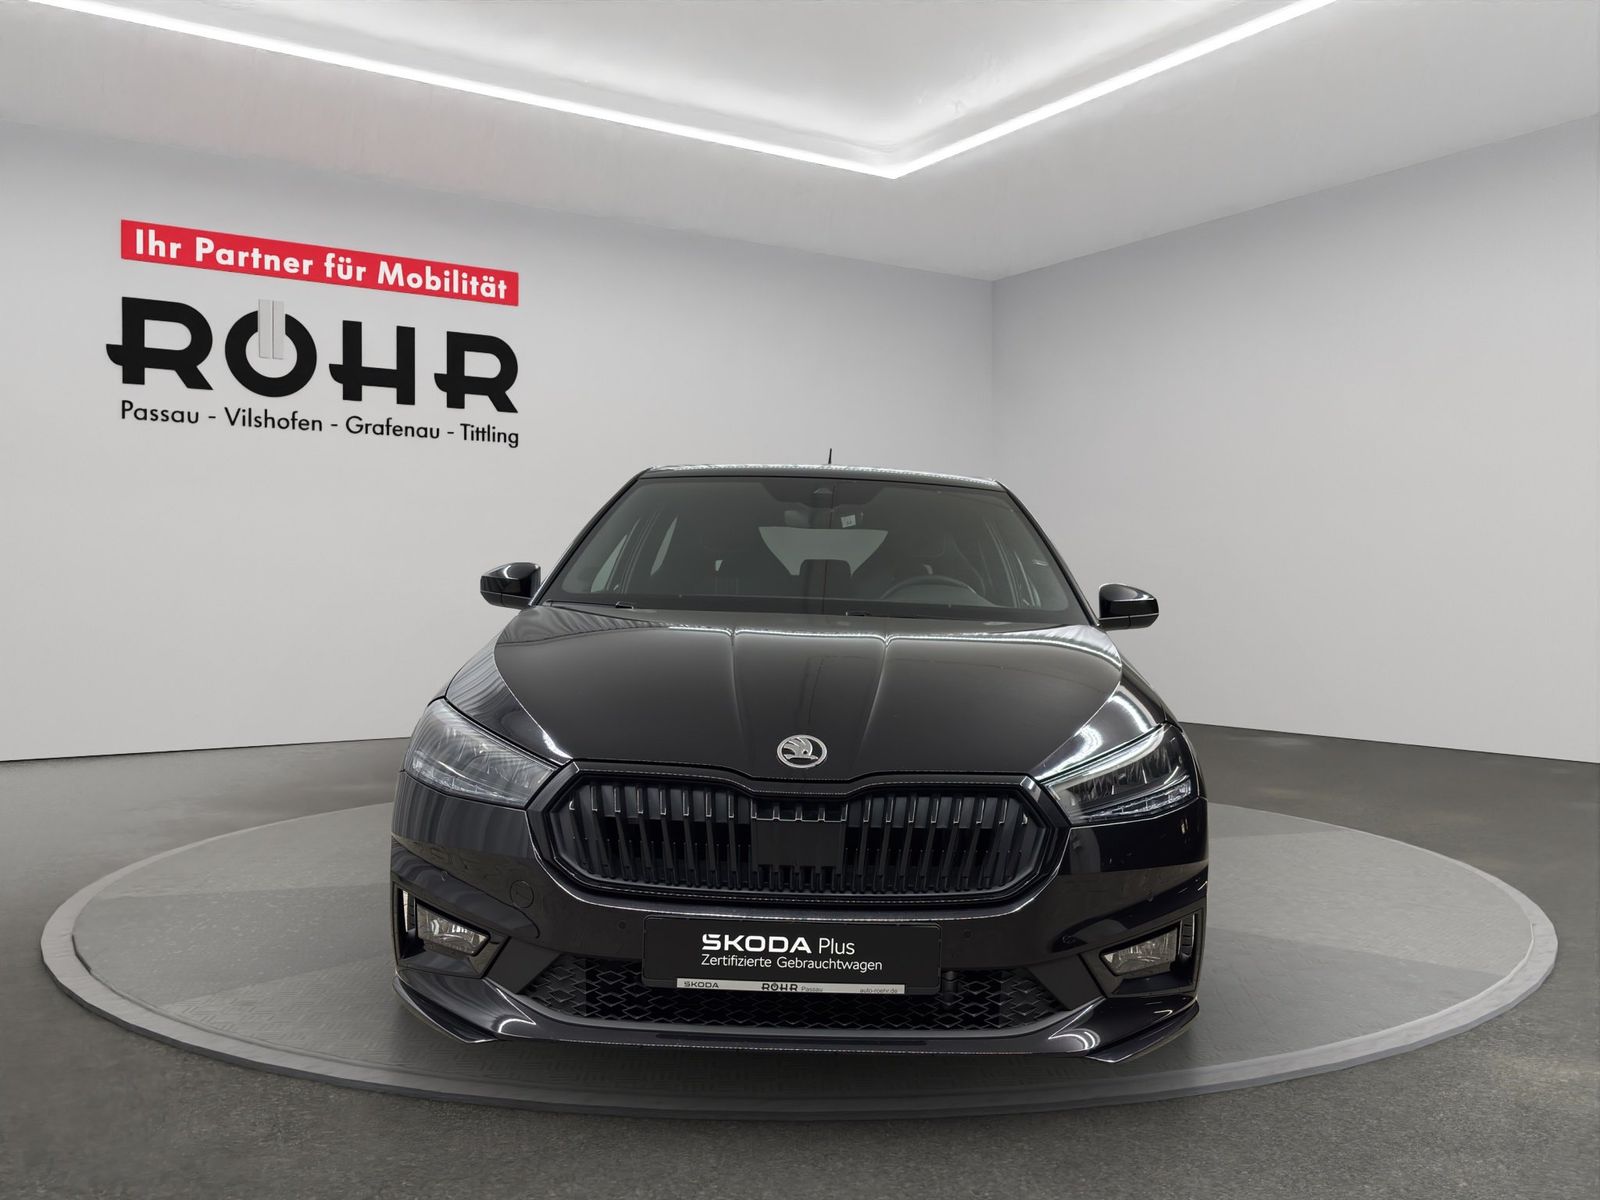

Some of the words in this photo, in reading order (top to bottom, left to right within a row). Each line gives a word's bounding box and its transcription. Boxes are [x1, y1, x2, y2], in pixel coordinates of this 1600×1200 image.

[135, 228, 182, 259] Ihr
[195, 236, 314, 275] Partner
[323, 252, 367, 282] für
[377, 260, 507, 299] Mobilität
[121, 400, 199, 424] Passau
[224, 407, 323, 432] Vilshofen
[345, 416, 440, 439] Grafenau
[460, 423, 519, 449] Tittling
[701, 954, 772, 968] Zertifizierte
[776, 956, 883, 973] Gebrauchtwagen
[818, 938, 855, 955] Plus
